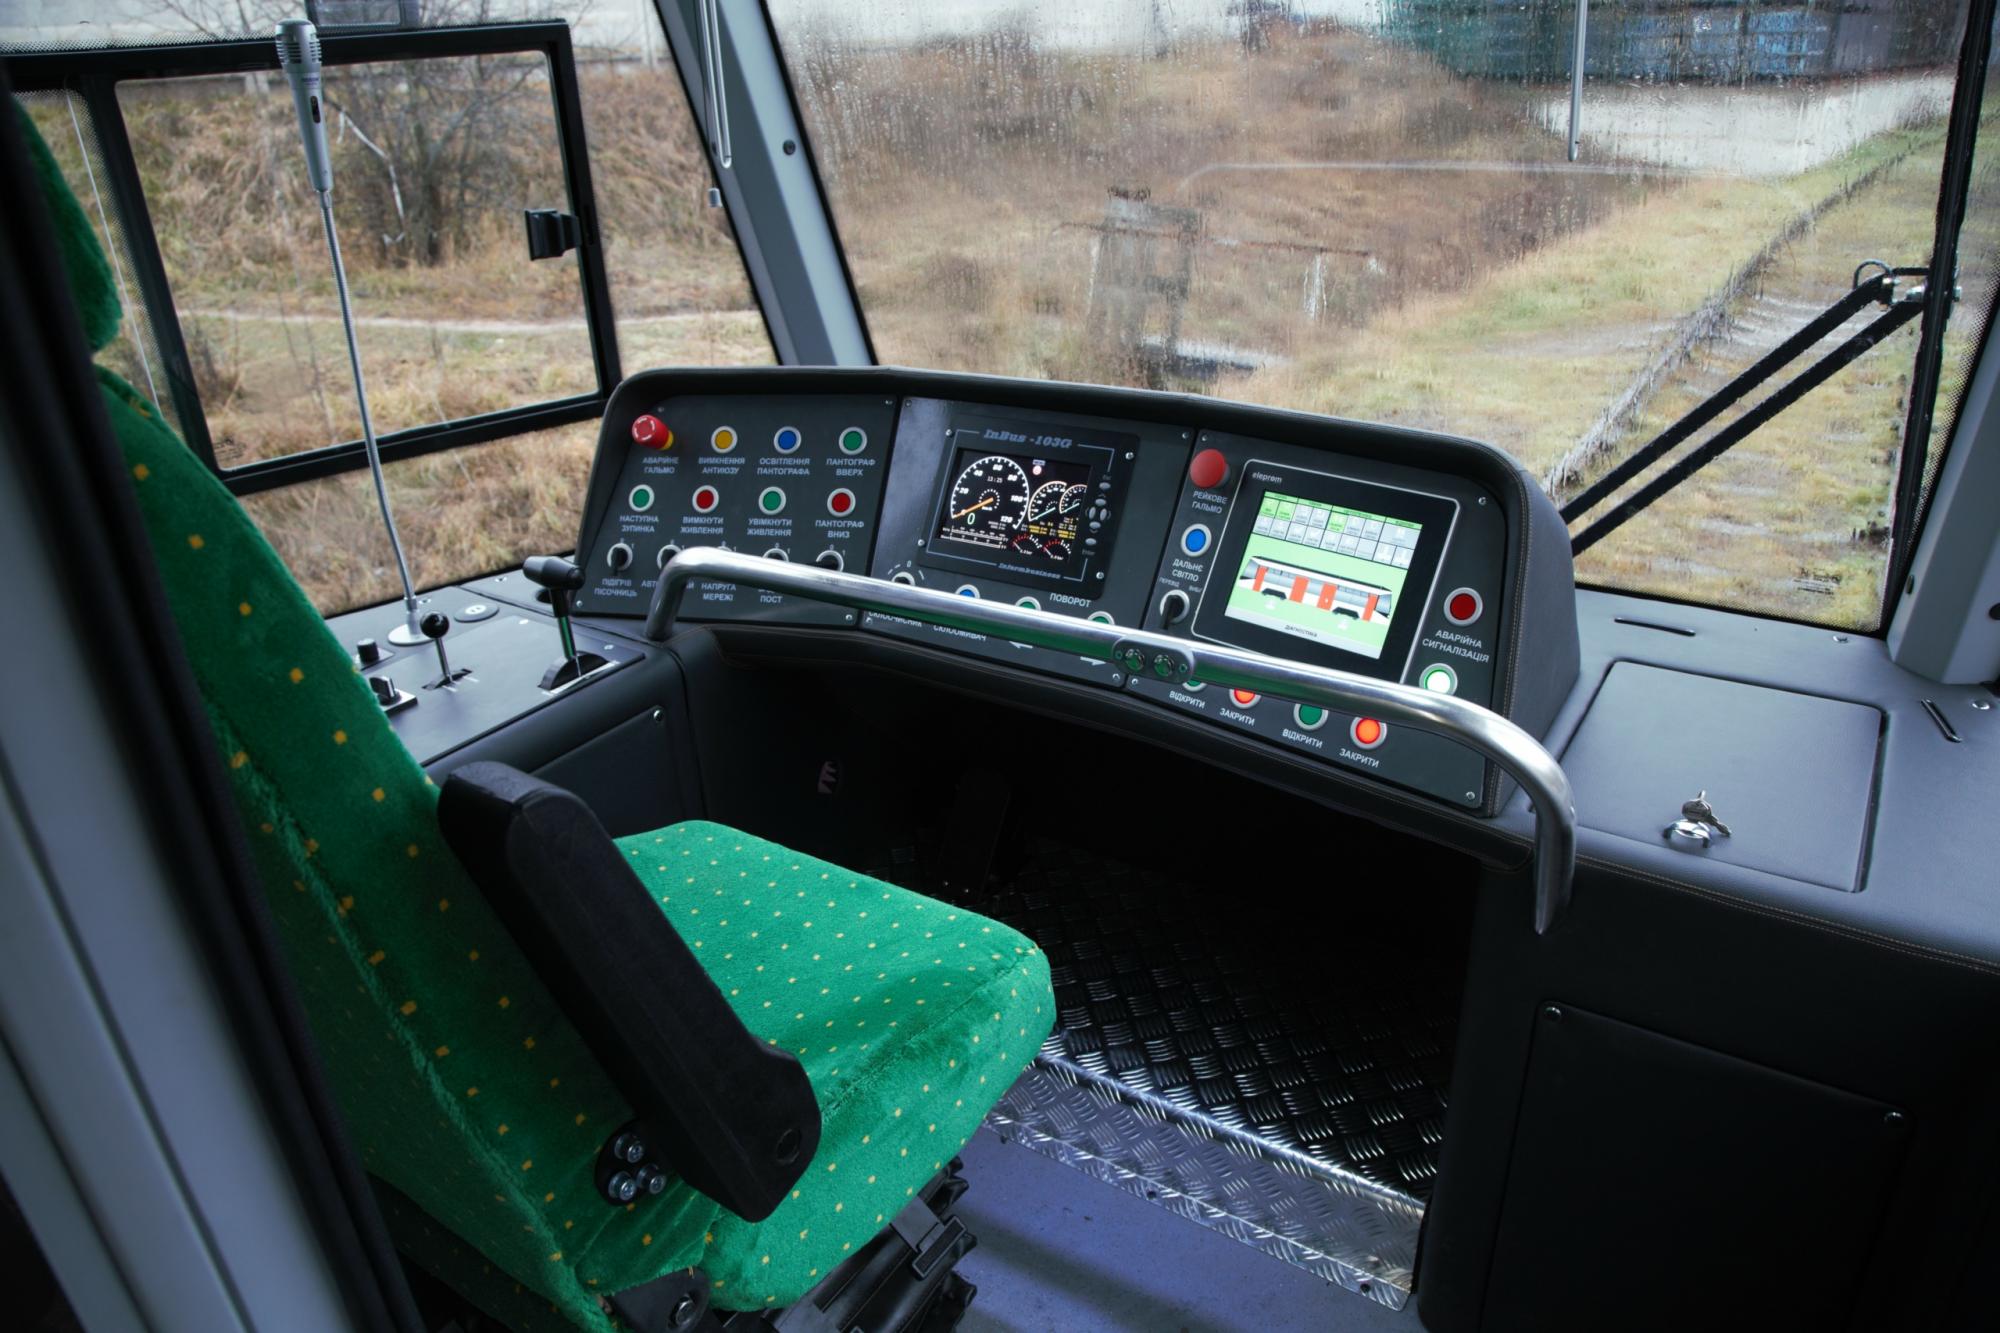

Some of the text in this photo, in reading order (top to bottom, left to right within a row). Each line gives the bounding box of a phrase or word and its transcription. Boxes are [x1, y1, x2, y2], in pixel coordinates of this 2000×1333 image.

[983, 429, 1026, 443] InBus
[759, 457, 810, 466] ОСВІТЛЕННЯ
[826, 458, 876, 467] ПАНТОГРАФ
[643, 466, 675, 475] ГАЛЬМО
[702, 467, 740, 475] АНТИЮЗУ
[757, 467, 810, 476] ПАНТОГРАФА
[836, 468, 864, 477] ВВЕРХ
[1193, 490, 1228, 505] РЕЙКОВЕ
[1191, 501, 1222, 514] ГАЛЬМО
[619, 515, 659, 523] НАСТУПНА
[682, 516, 724, 525] ВИМКНУТИ
[748, 518, 792, 527] УВІМКНУТИ
[967, 512, 976, 525] 0
[815, 519, 865, 528] ПАНТОГРАФ
[621, 525, 655, 533] ЗУПИНКА
[680, 526, 724, 535] ЖИВЛЕННЯ
[747, 528, 792, 537] ЖИВЛЕННЯ
[827, 530, 850, 539] ВНИЗ
[1172, 569, 1199, 582] СВІТЛО
[701, 582, 736, 591] НАПРУГА
[703, 593, 733, 602] МЕРЕЖІ
[760, 595, 783, 604] ПОСТ
[1049, 592, 1092, 608] ПОВОРОТ
[1435, 629, 1482, 649] АВАРІЙНА
[1422, 638, 1490, 663] СИГНАЛІЗАЦІЯ
[1169, 690, 1206, 709] ВІДКРИТИ
[1219, 707, 1256, 726] ЗАКРИТИ
[1282, 728, 1323, 749] ВІДКРИТИ
[1339, 748, 1379, 768] ЗАКРИТИ
